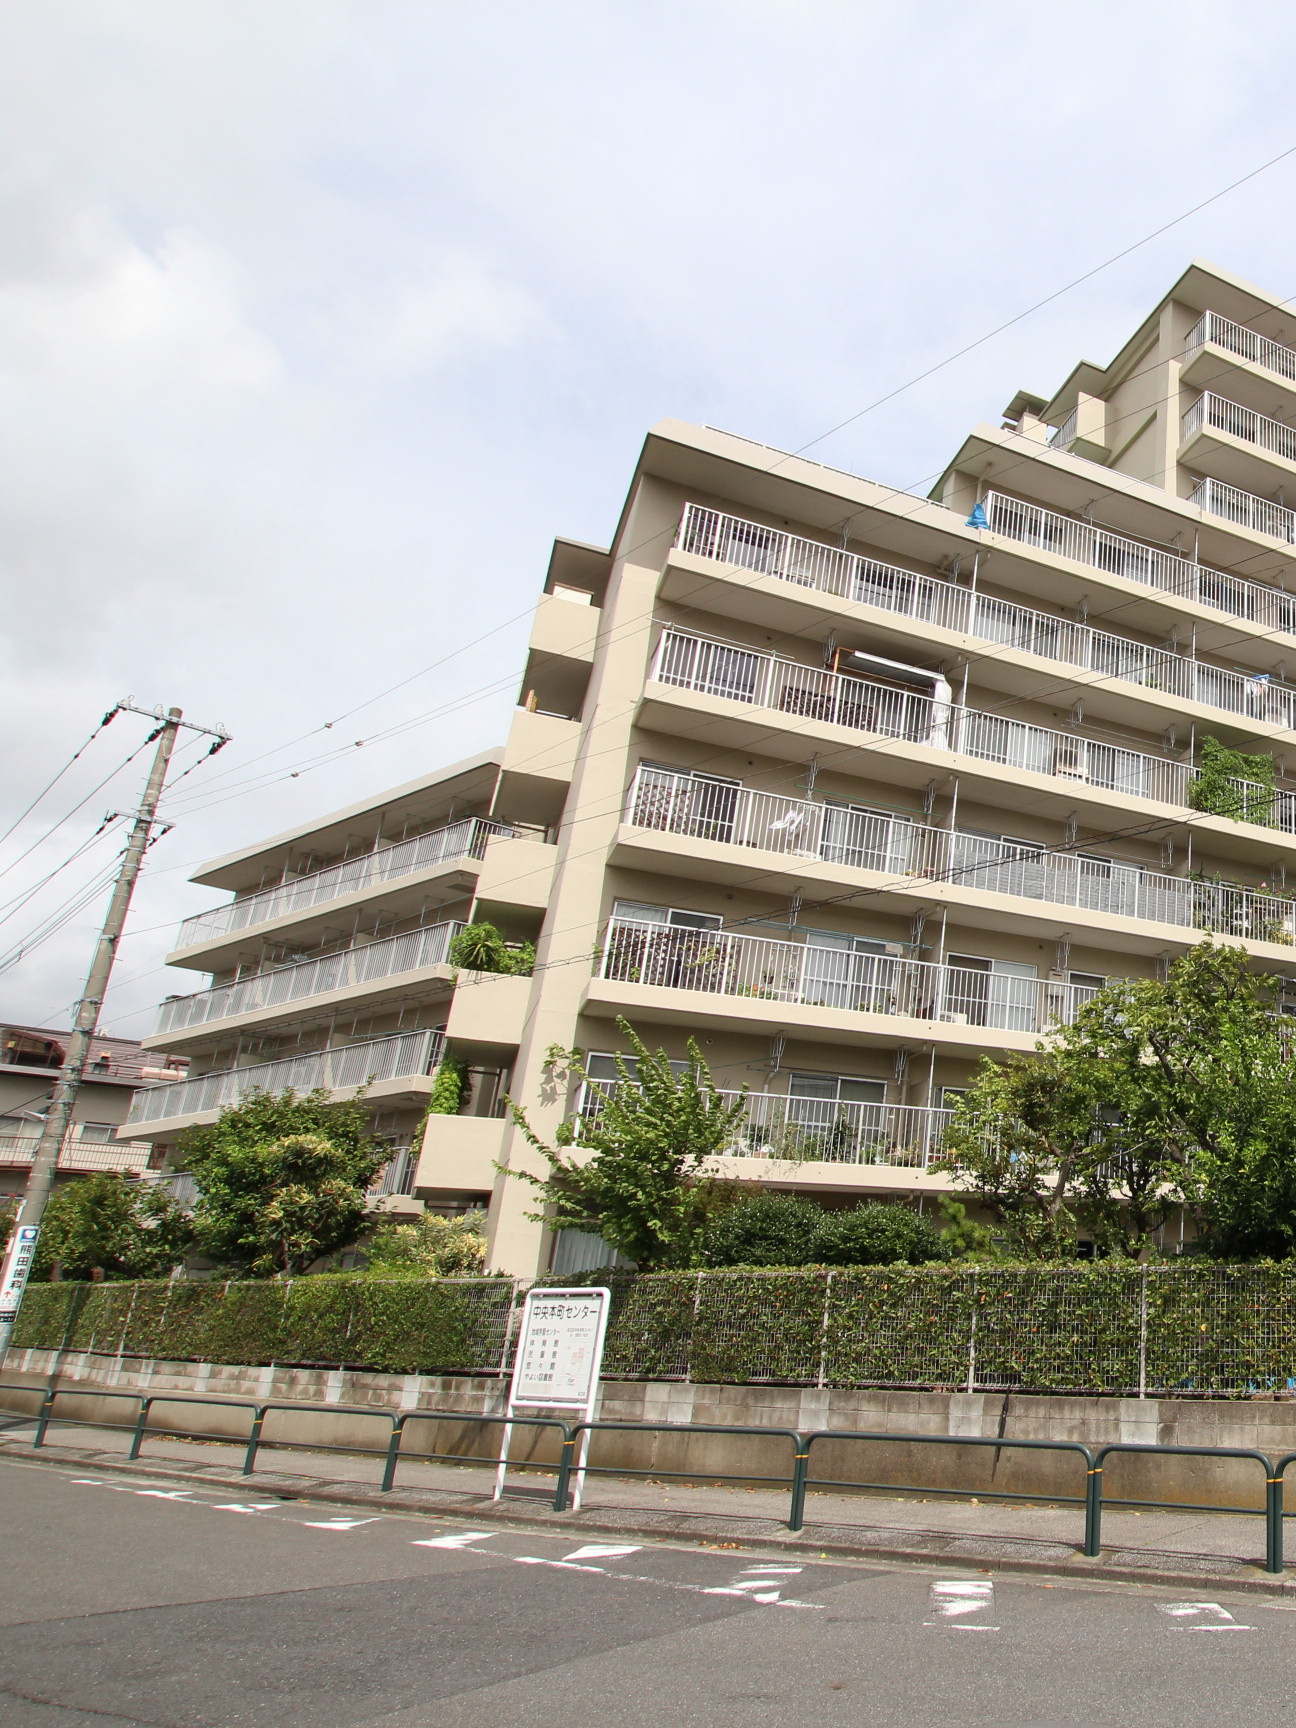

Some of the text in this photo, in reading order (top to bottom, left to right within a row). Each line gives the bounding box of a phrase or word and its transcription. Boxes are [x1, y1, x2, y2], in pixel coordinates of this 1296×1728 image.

[533, 1304, 597, 1320] 中央本町センター
